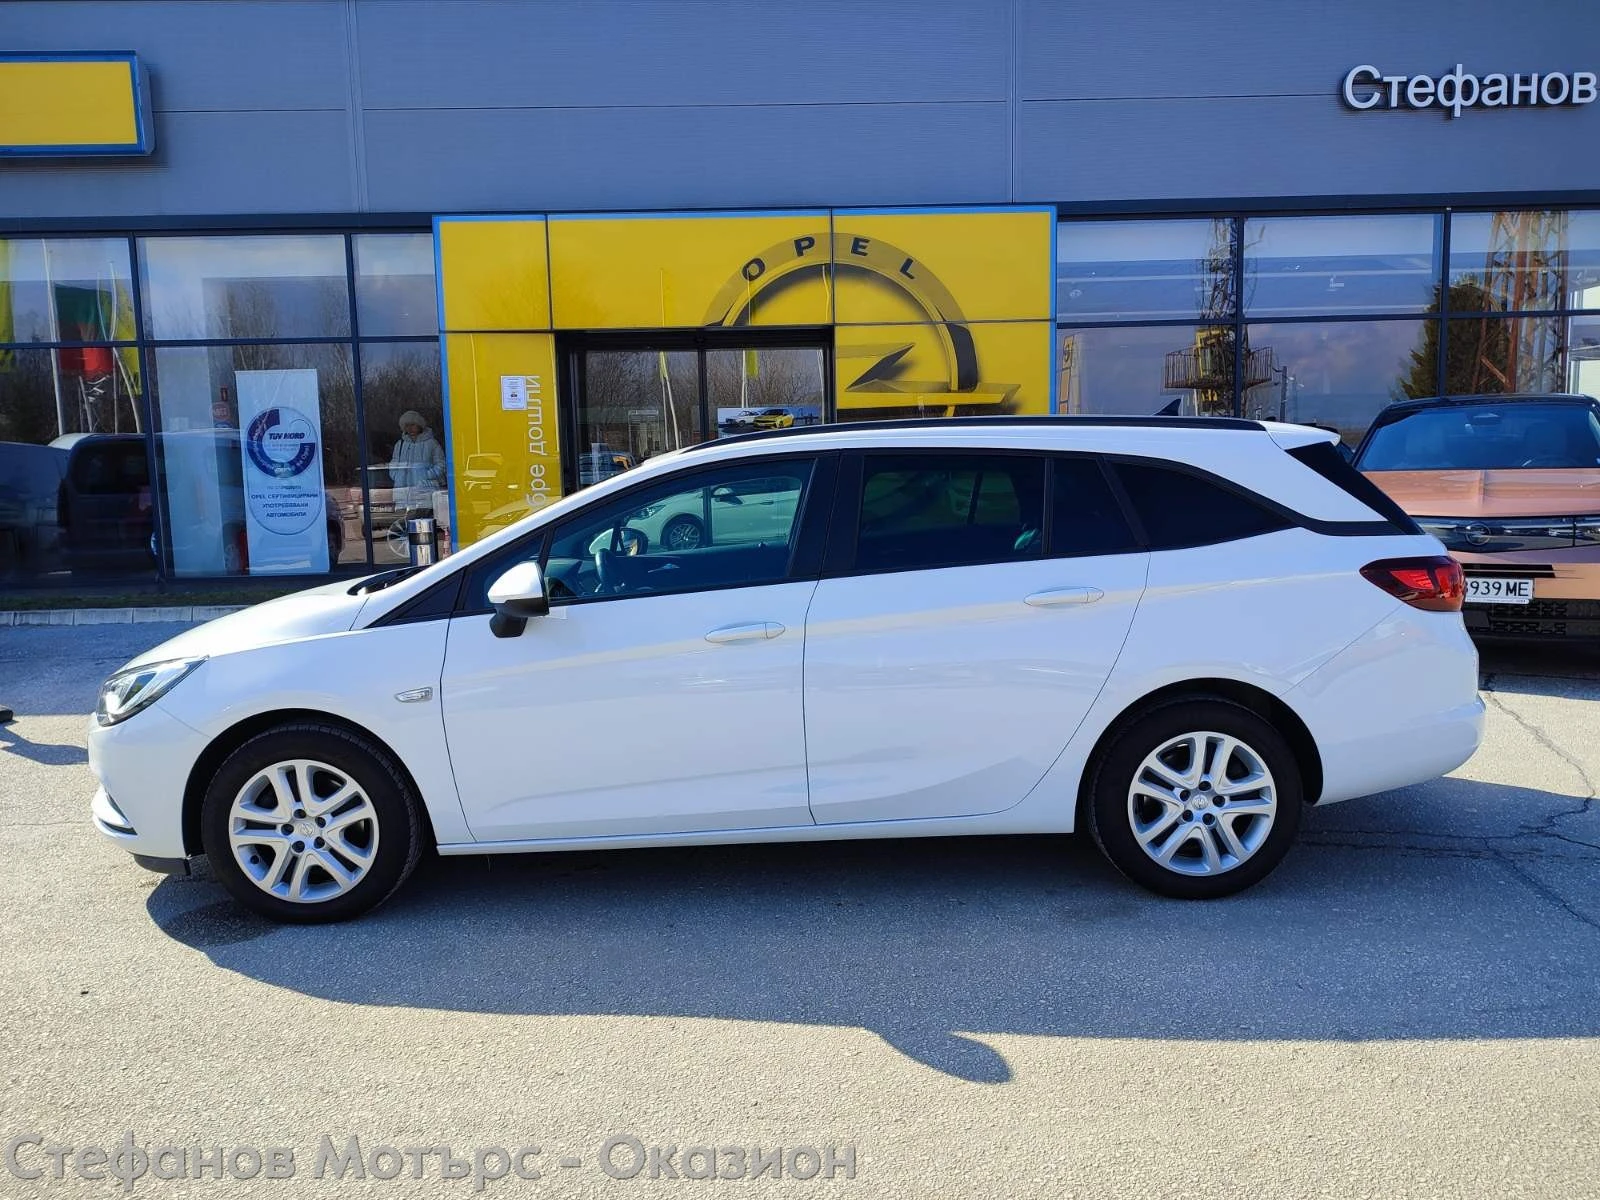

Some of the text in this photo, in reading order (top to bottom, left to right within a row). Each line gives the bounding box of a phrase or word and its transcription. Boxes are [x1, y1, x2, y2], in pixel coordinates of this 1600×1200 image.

[1344, 63, 1598, 118] Стефанов
[741, 236, 916, 281] OPEL
[283, 432, 306, 440] NORD
[526, 375, 548, 456] дошли
[1505, 581, 1529, 597] ME
